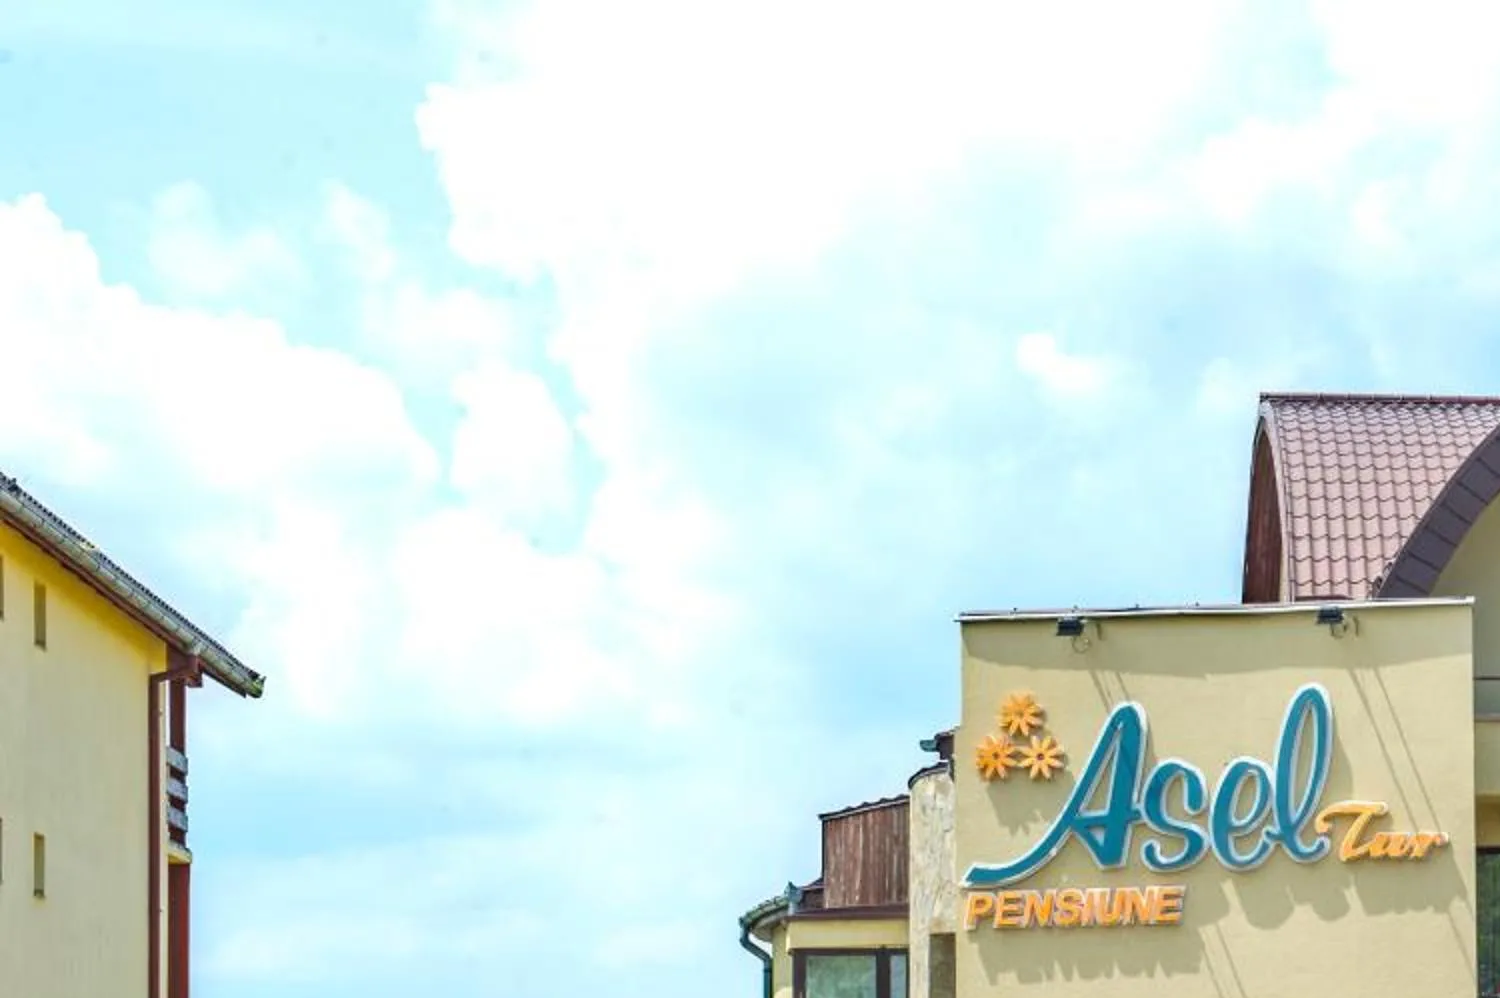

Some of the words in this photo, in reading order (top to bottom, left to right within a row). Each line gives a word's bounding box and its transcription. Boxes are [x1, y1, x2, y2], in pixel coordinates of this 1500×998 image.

[961, 682, 1334, 888] Asel
[1314, 801, 1450, 864] Tur
[964, 885, 1185, 930] PENSIUNE
